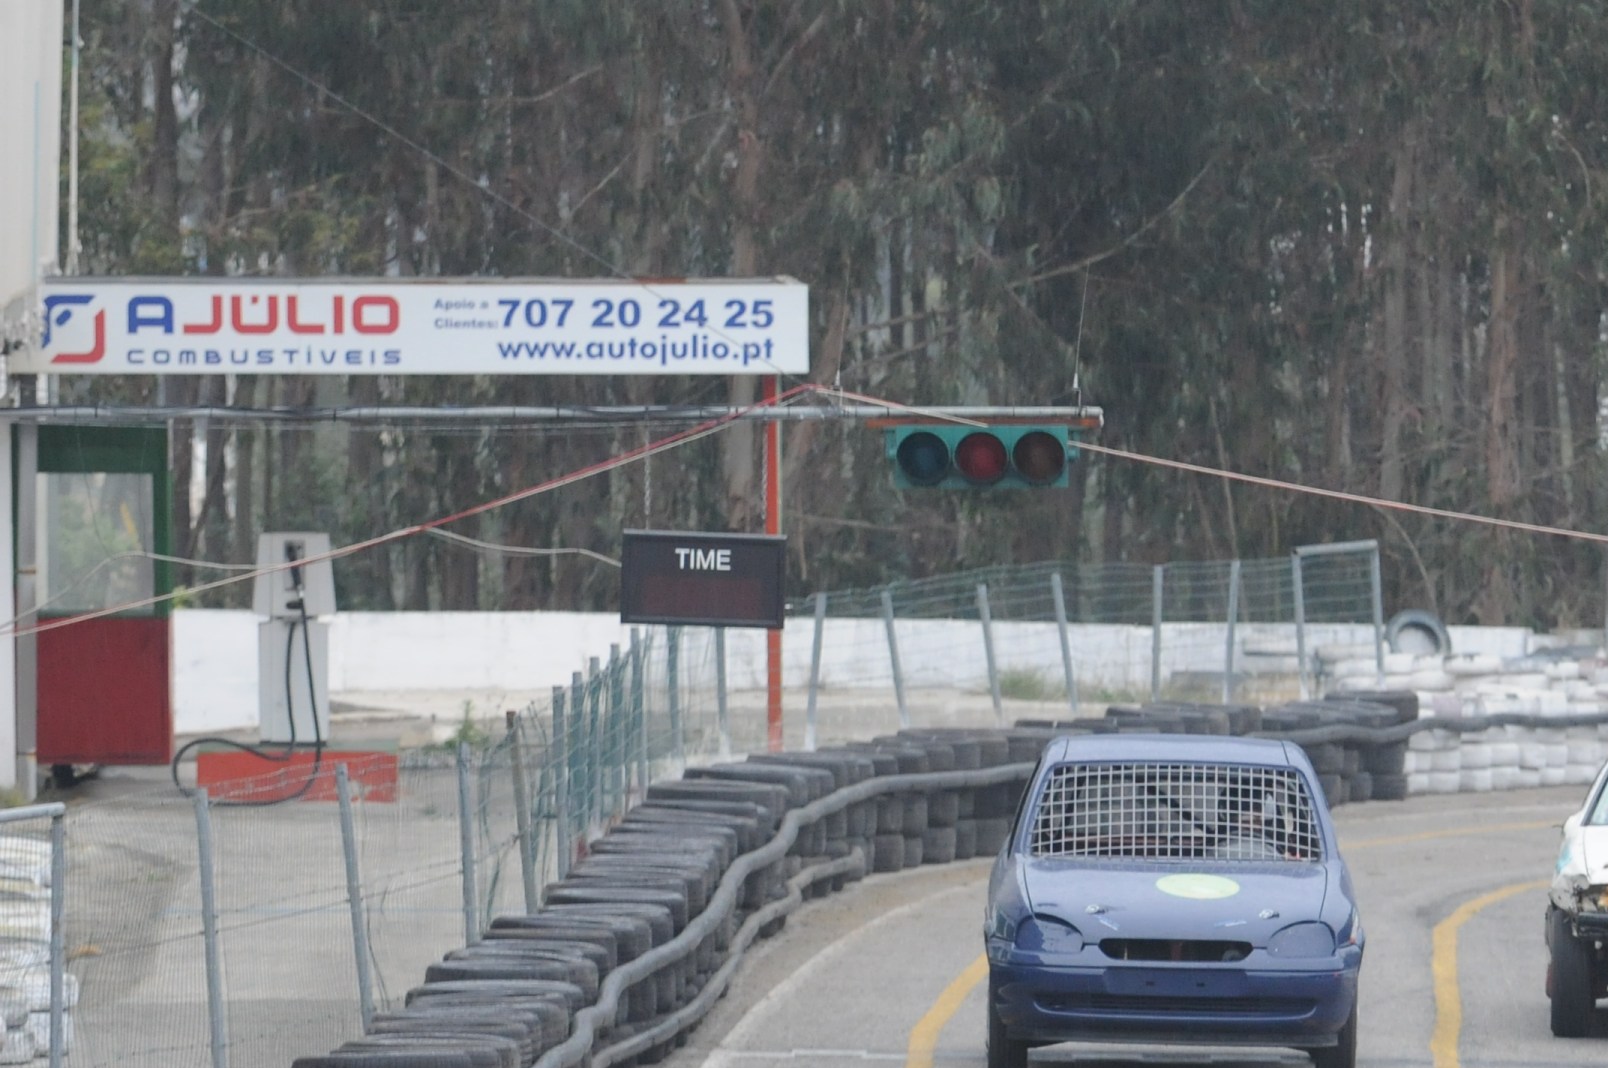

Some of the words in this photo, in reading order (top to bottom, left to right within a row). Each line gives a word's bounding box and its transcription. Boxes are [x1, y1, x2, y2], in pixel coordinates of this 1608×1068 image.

[434, 298, 475, 312] Apoio
[479, 301, 489, 310] a
[497, 298, 575, 328] 707
[591, 298, 641, 328] 20
[657, 299, 708, 328] 24
[724, 299, 774, 329] 25
[434, 317, 498, 330] Clientes:
[127, 346, 401, 365] COMBUSTÍVEIS
[497, 333, 774, 366] www.autojulio.pt
[674, 547, 732, 571] TIME
